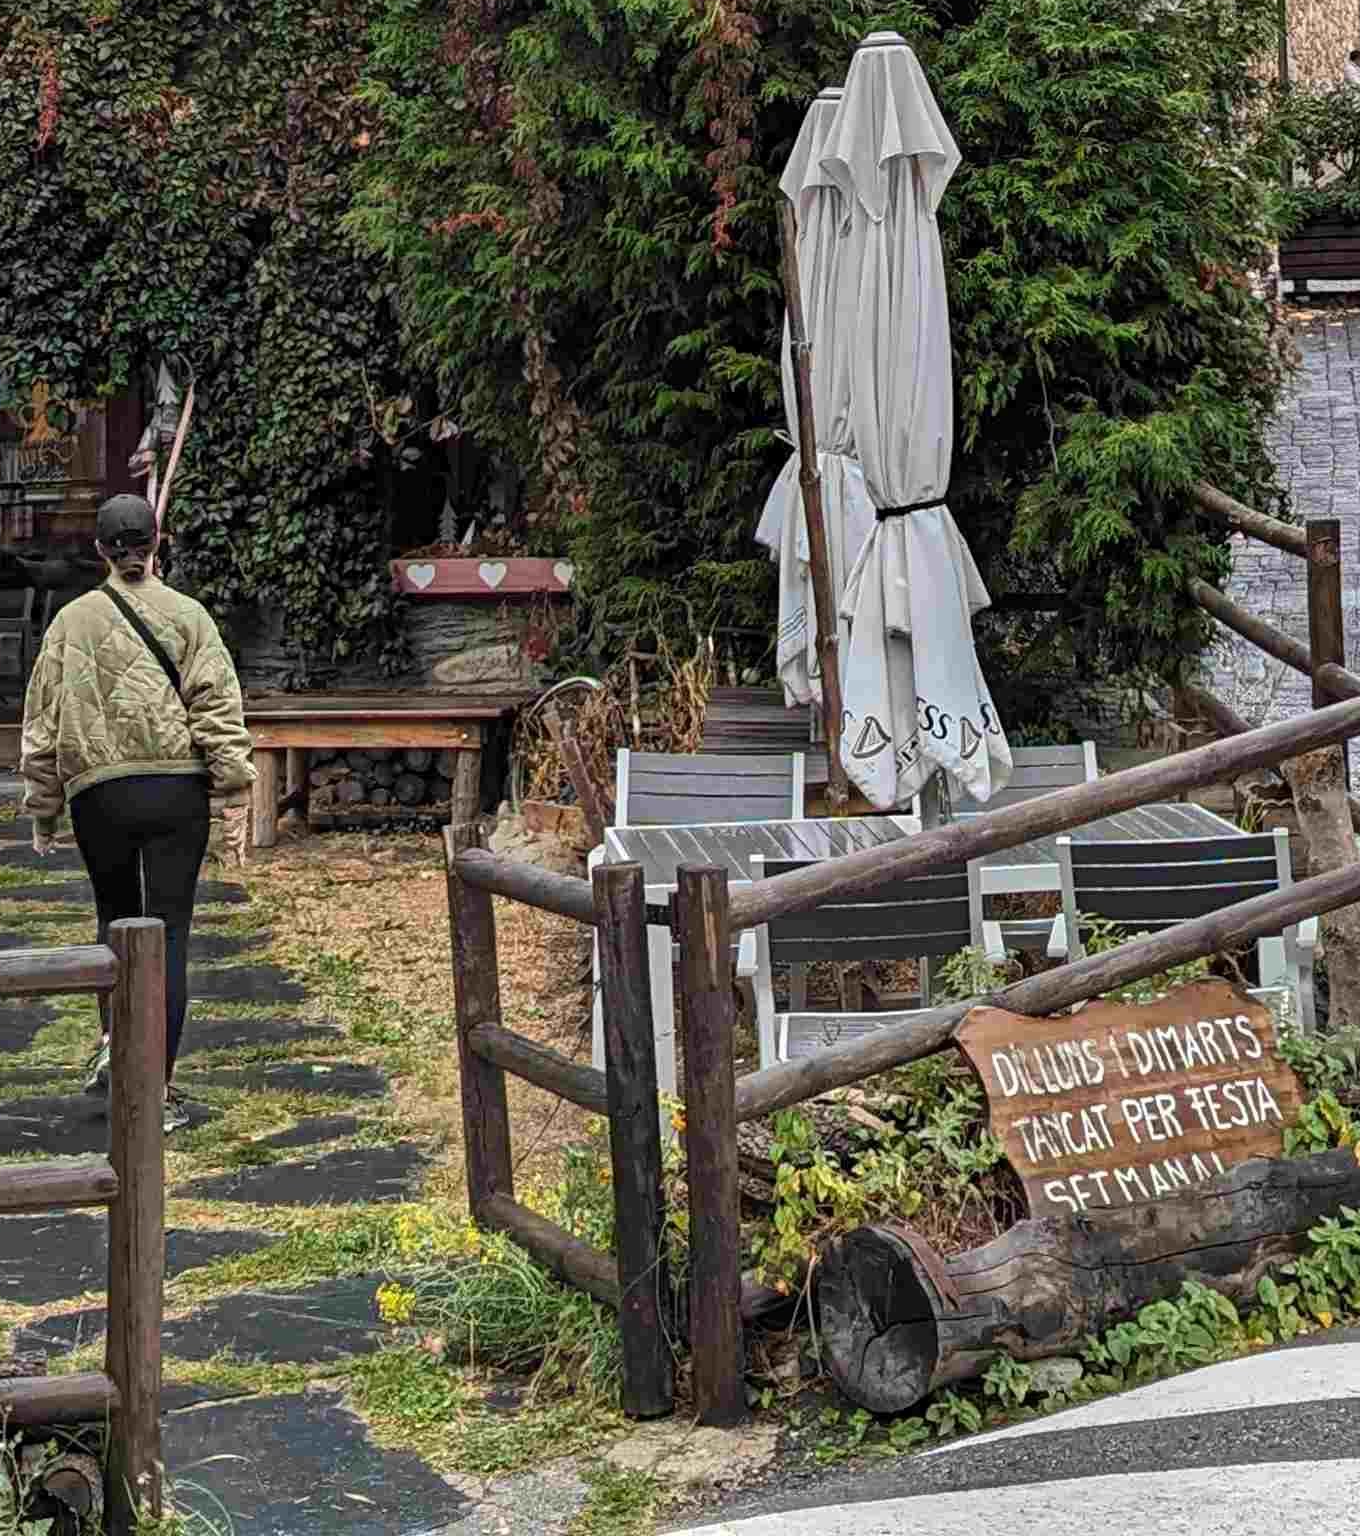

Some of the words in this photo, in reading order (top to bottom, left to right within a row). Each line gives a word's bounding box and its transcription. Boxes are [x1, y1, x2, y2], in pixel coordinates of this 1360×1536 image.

[1127, 1015, 1262, 1076] DIMARTS
[1011, 1103, 1115, 1163] TANCAT
[1121, 1093, 1184, 1144] PER
[1184, 1077, 1284, 1131] FESTA
